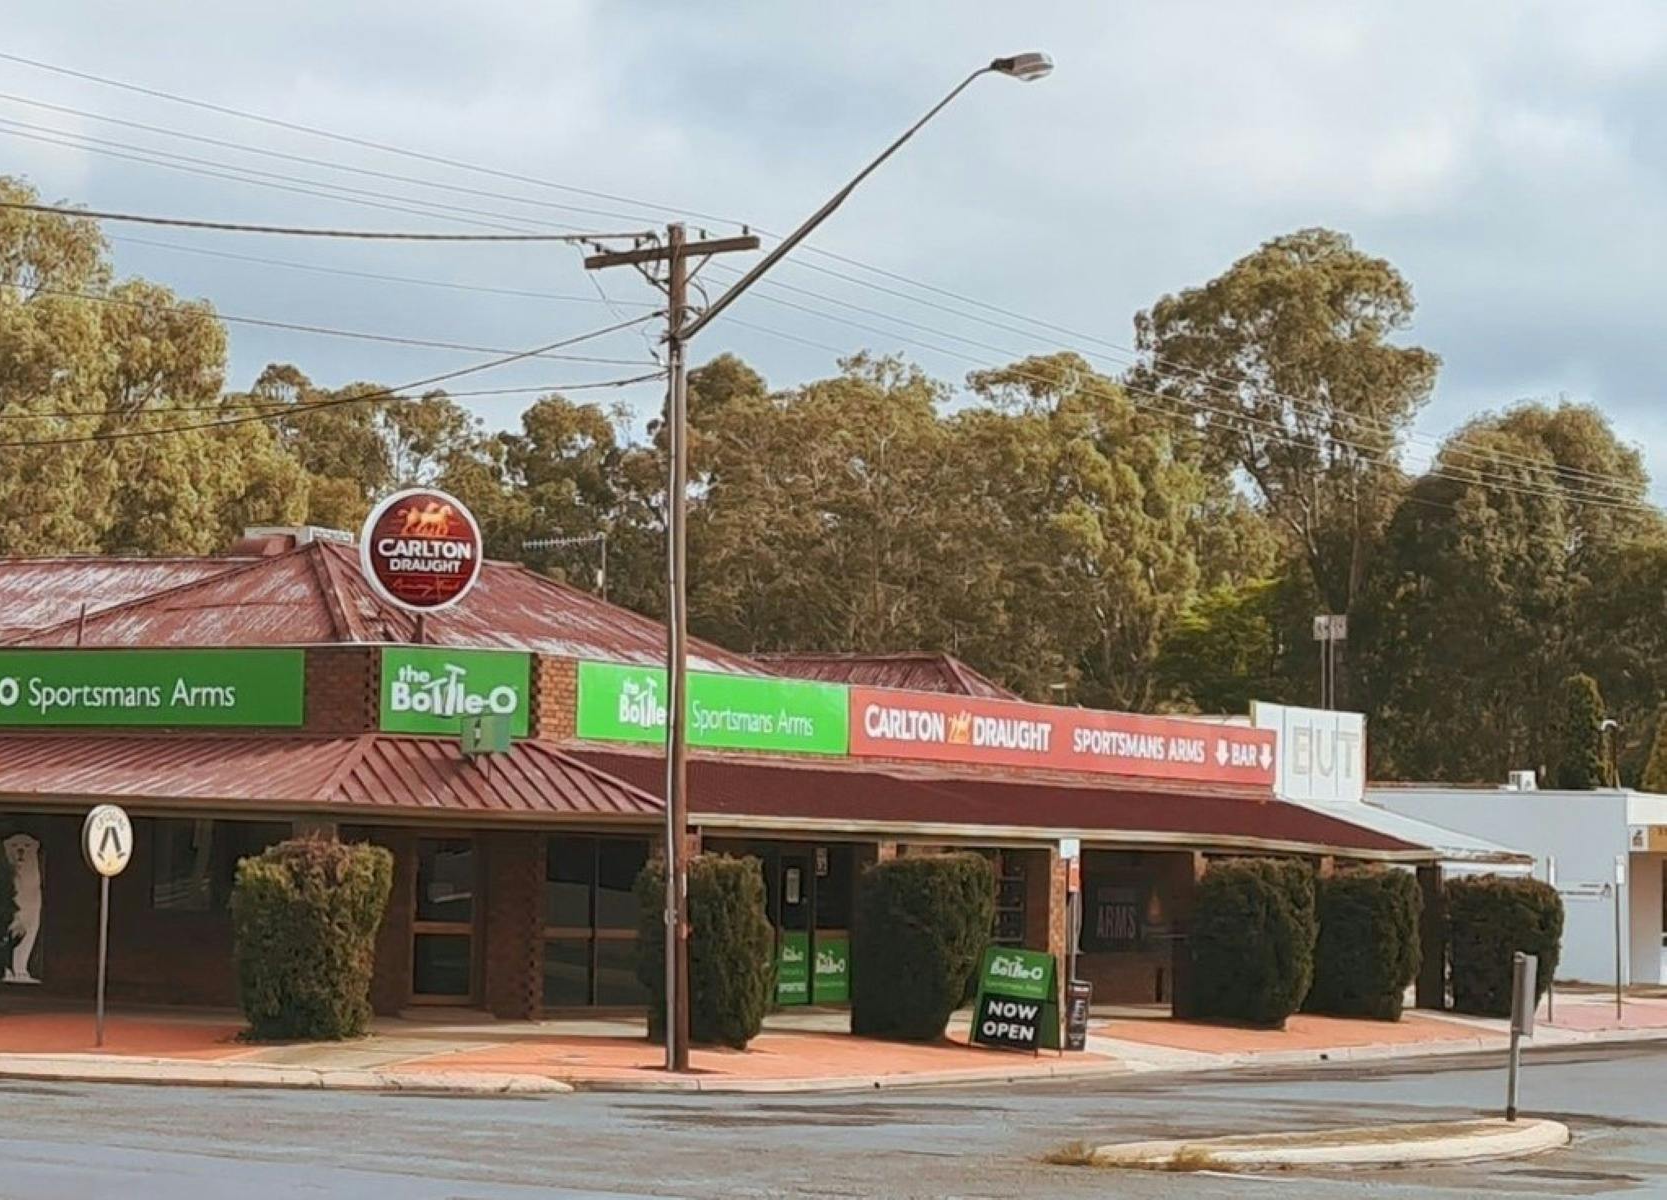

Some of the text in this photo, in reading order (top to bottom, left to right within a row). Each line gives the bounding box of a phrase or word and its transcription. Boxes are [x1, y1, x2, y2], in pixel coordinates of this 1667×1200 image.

[378, 538, 471, 560] CARLTON
[389, 559, 461, 574] DRAUGHT
[398, 663, 430, 683] the
[28, 677, 161, 715] Sportsmans
[170, 677, 236, 707] Arms
[692, 700, 773, 736] Sportsmans
[777, 708, 814, 737] Arms
[865, 704, 1257, 768] CARLTON DRAUGHT SPORTSMANS ARMS BAR
[987, 1000, 1038, 1021] NOW
[982, 1020, 1034, 1041] OPEN
